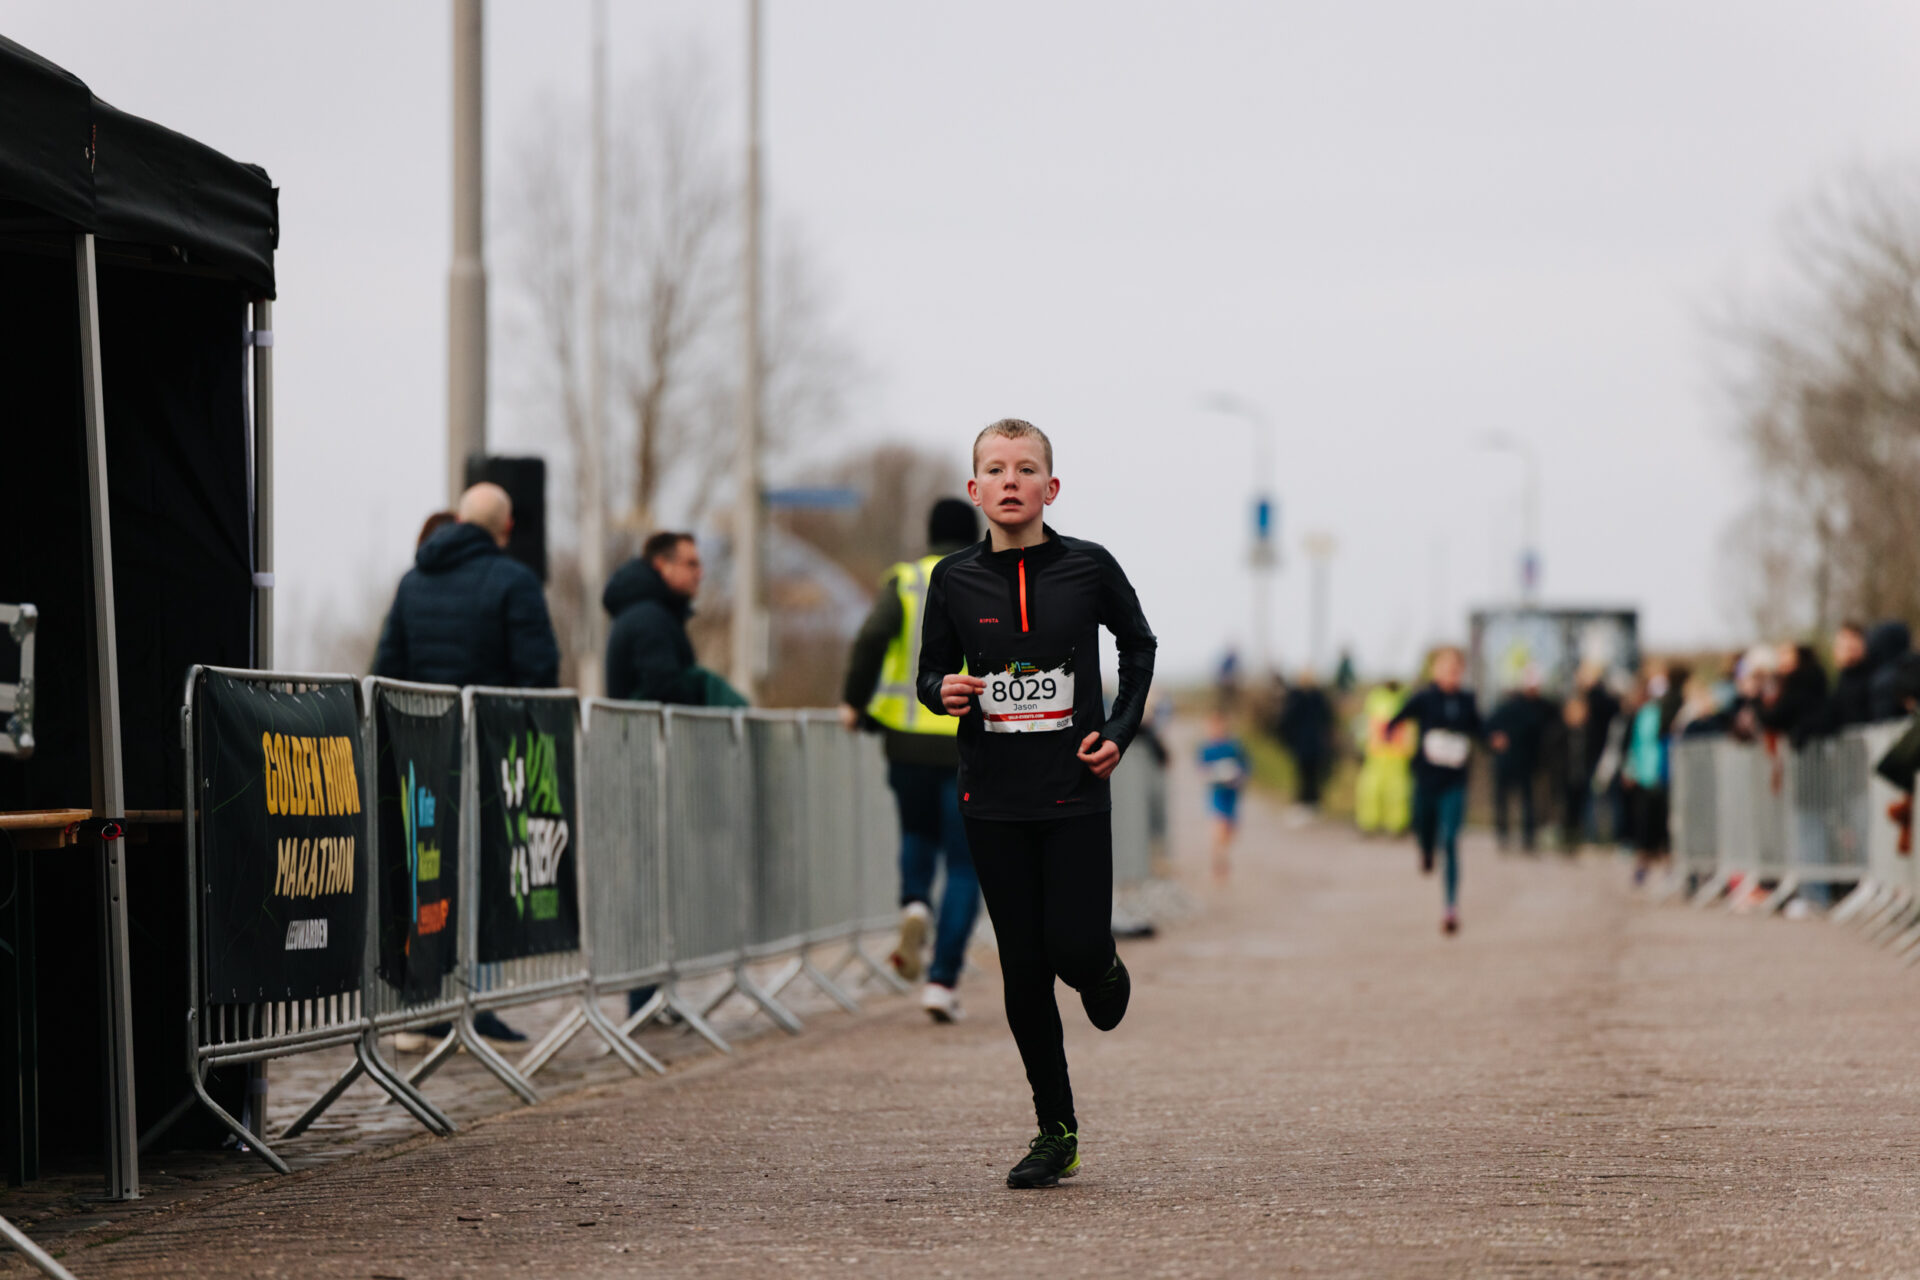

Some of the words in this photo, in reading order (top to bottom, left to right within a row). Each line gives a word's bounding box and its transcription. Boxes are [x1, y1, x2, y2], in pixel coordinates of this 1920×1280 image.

[992, 678, 1056, 702] 8029
[1013, 703, 1038, 711] Jason
[262, 731, 325, 816] GOLDEN
[320, 736, 361, 816] HOUR
[275, 835, 354, 900] MARATHON
